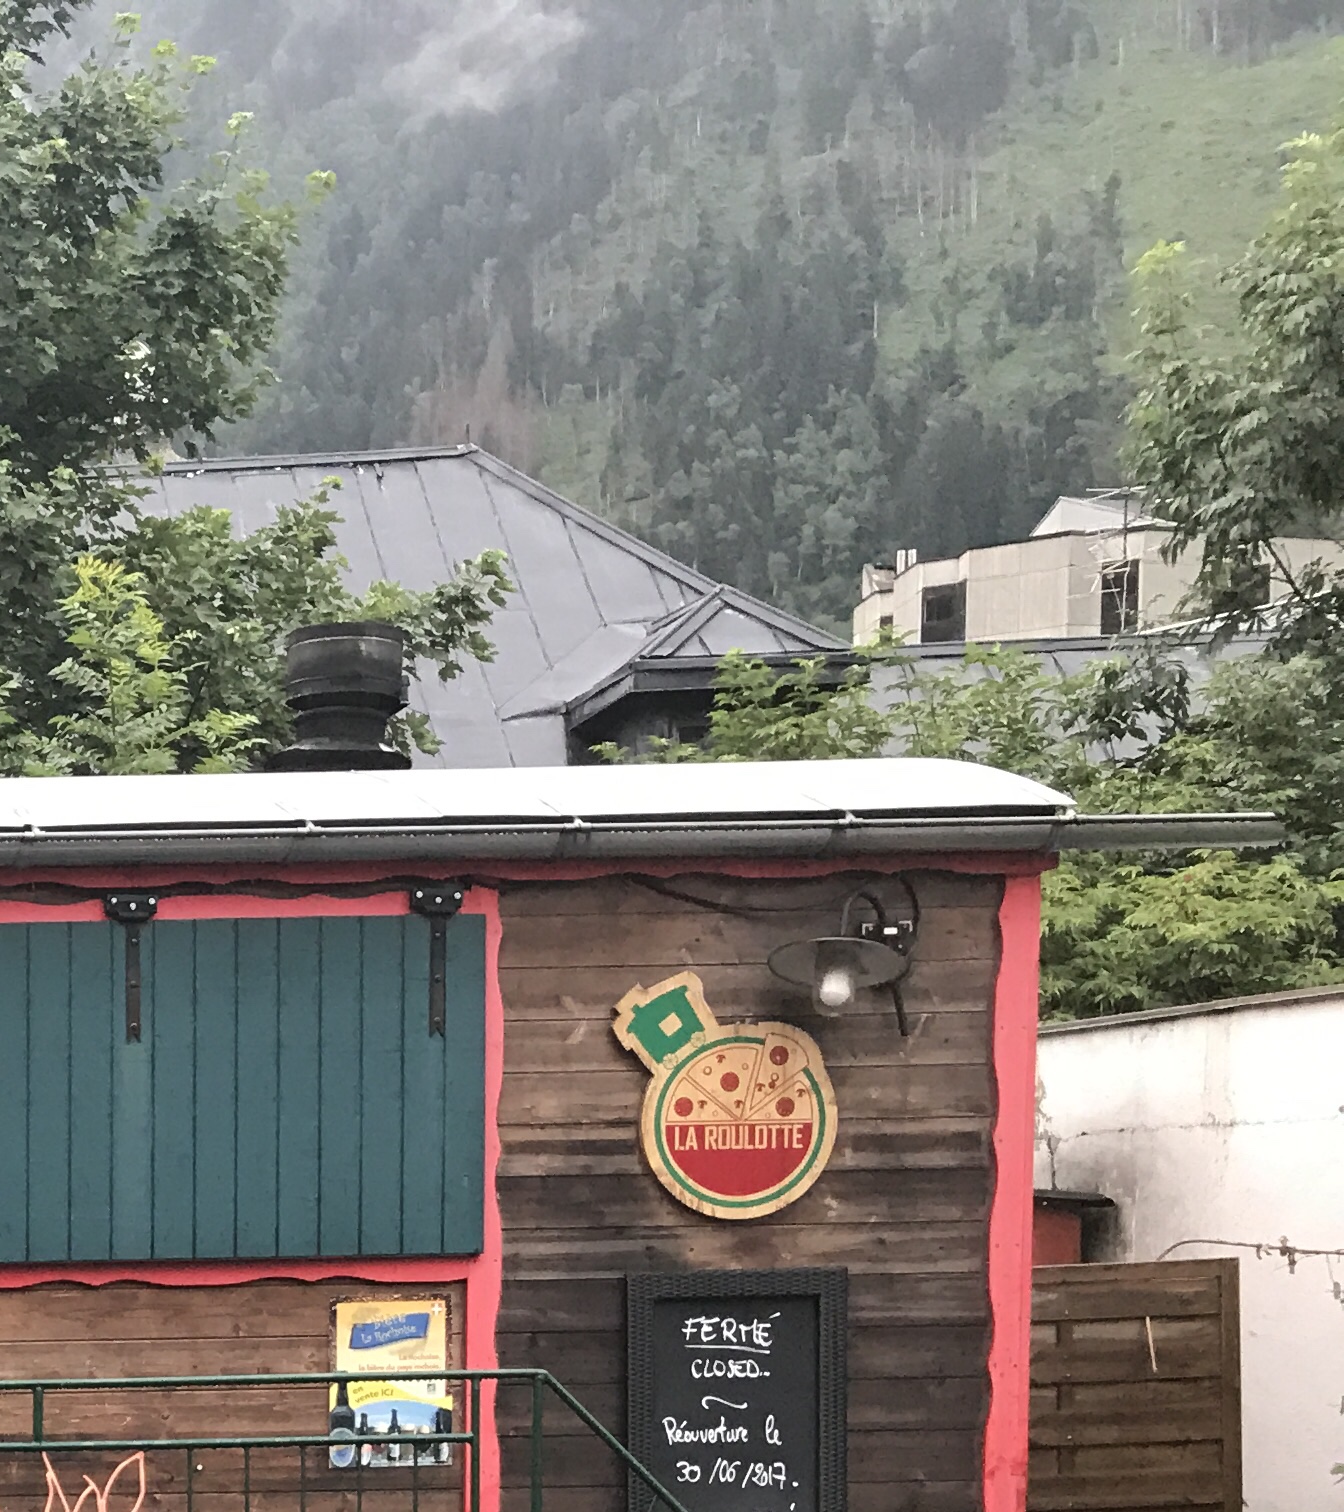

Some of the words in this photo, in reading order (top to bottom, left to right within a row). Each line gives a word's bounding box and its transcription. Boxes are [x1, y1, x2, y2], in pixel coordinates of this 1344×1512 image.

[674, 1126, 698, 1151] LA
[704, 1124, 804, 1150] ROULOTTE
[681, 1312, 782, 1347] FERMÉ
[351, 1386, 364, 1395] en
[354, 1390, 380, 1404] vente
[381, 1388, 395, 1397] ICI
[662, 1416, 749, 1446] Réouverture
[765, 1415, 782, 1446] le
